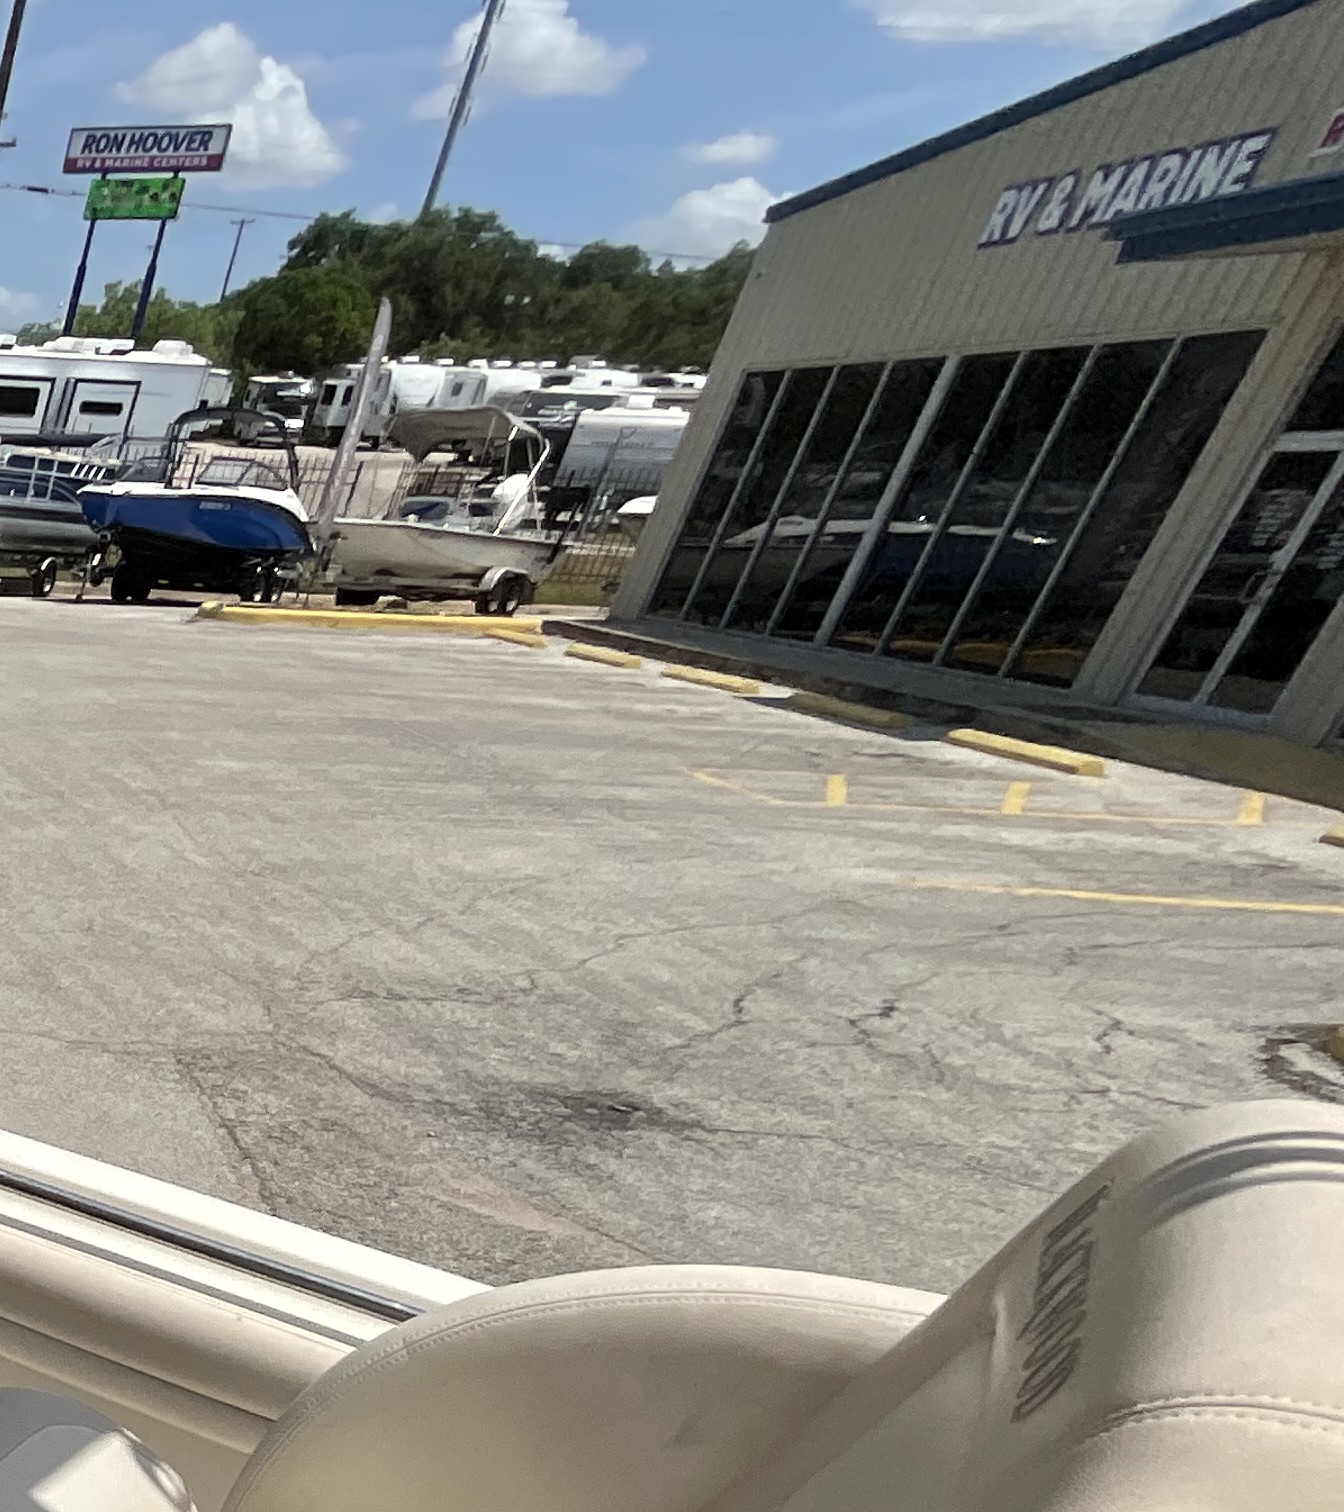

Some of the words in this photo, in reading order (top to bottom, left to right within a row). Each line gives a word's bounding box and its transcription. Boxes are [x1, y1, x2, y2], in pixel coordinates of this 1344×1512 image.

[80, 132, 127, 155] RON
[128, 130, 214, 152] HOOVER
[76, 158, 93, 169] RV
[105, 157, 149, 168] MARINE
[153, 155, 208, 167] CENTERS
[977, 178, 1054, 249] RV
[1036, 169, 1081, 236] &
[1069, 127, 1278, 233] MARINE
